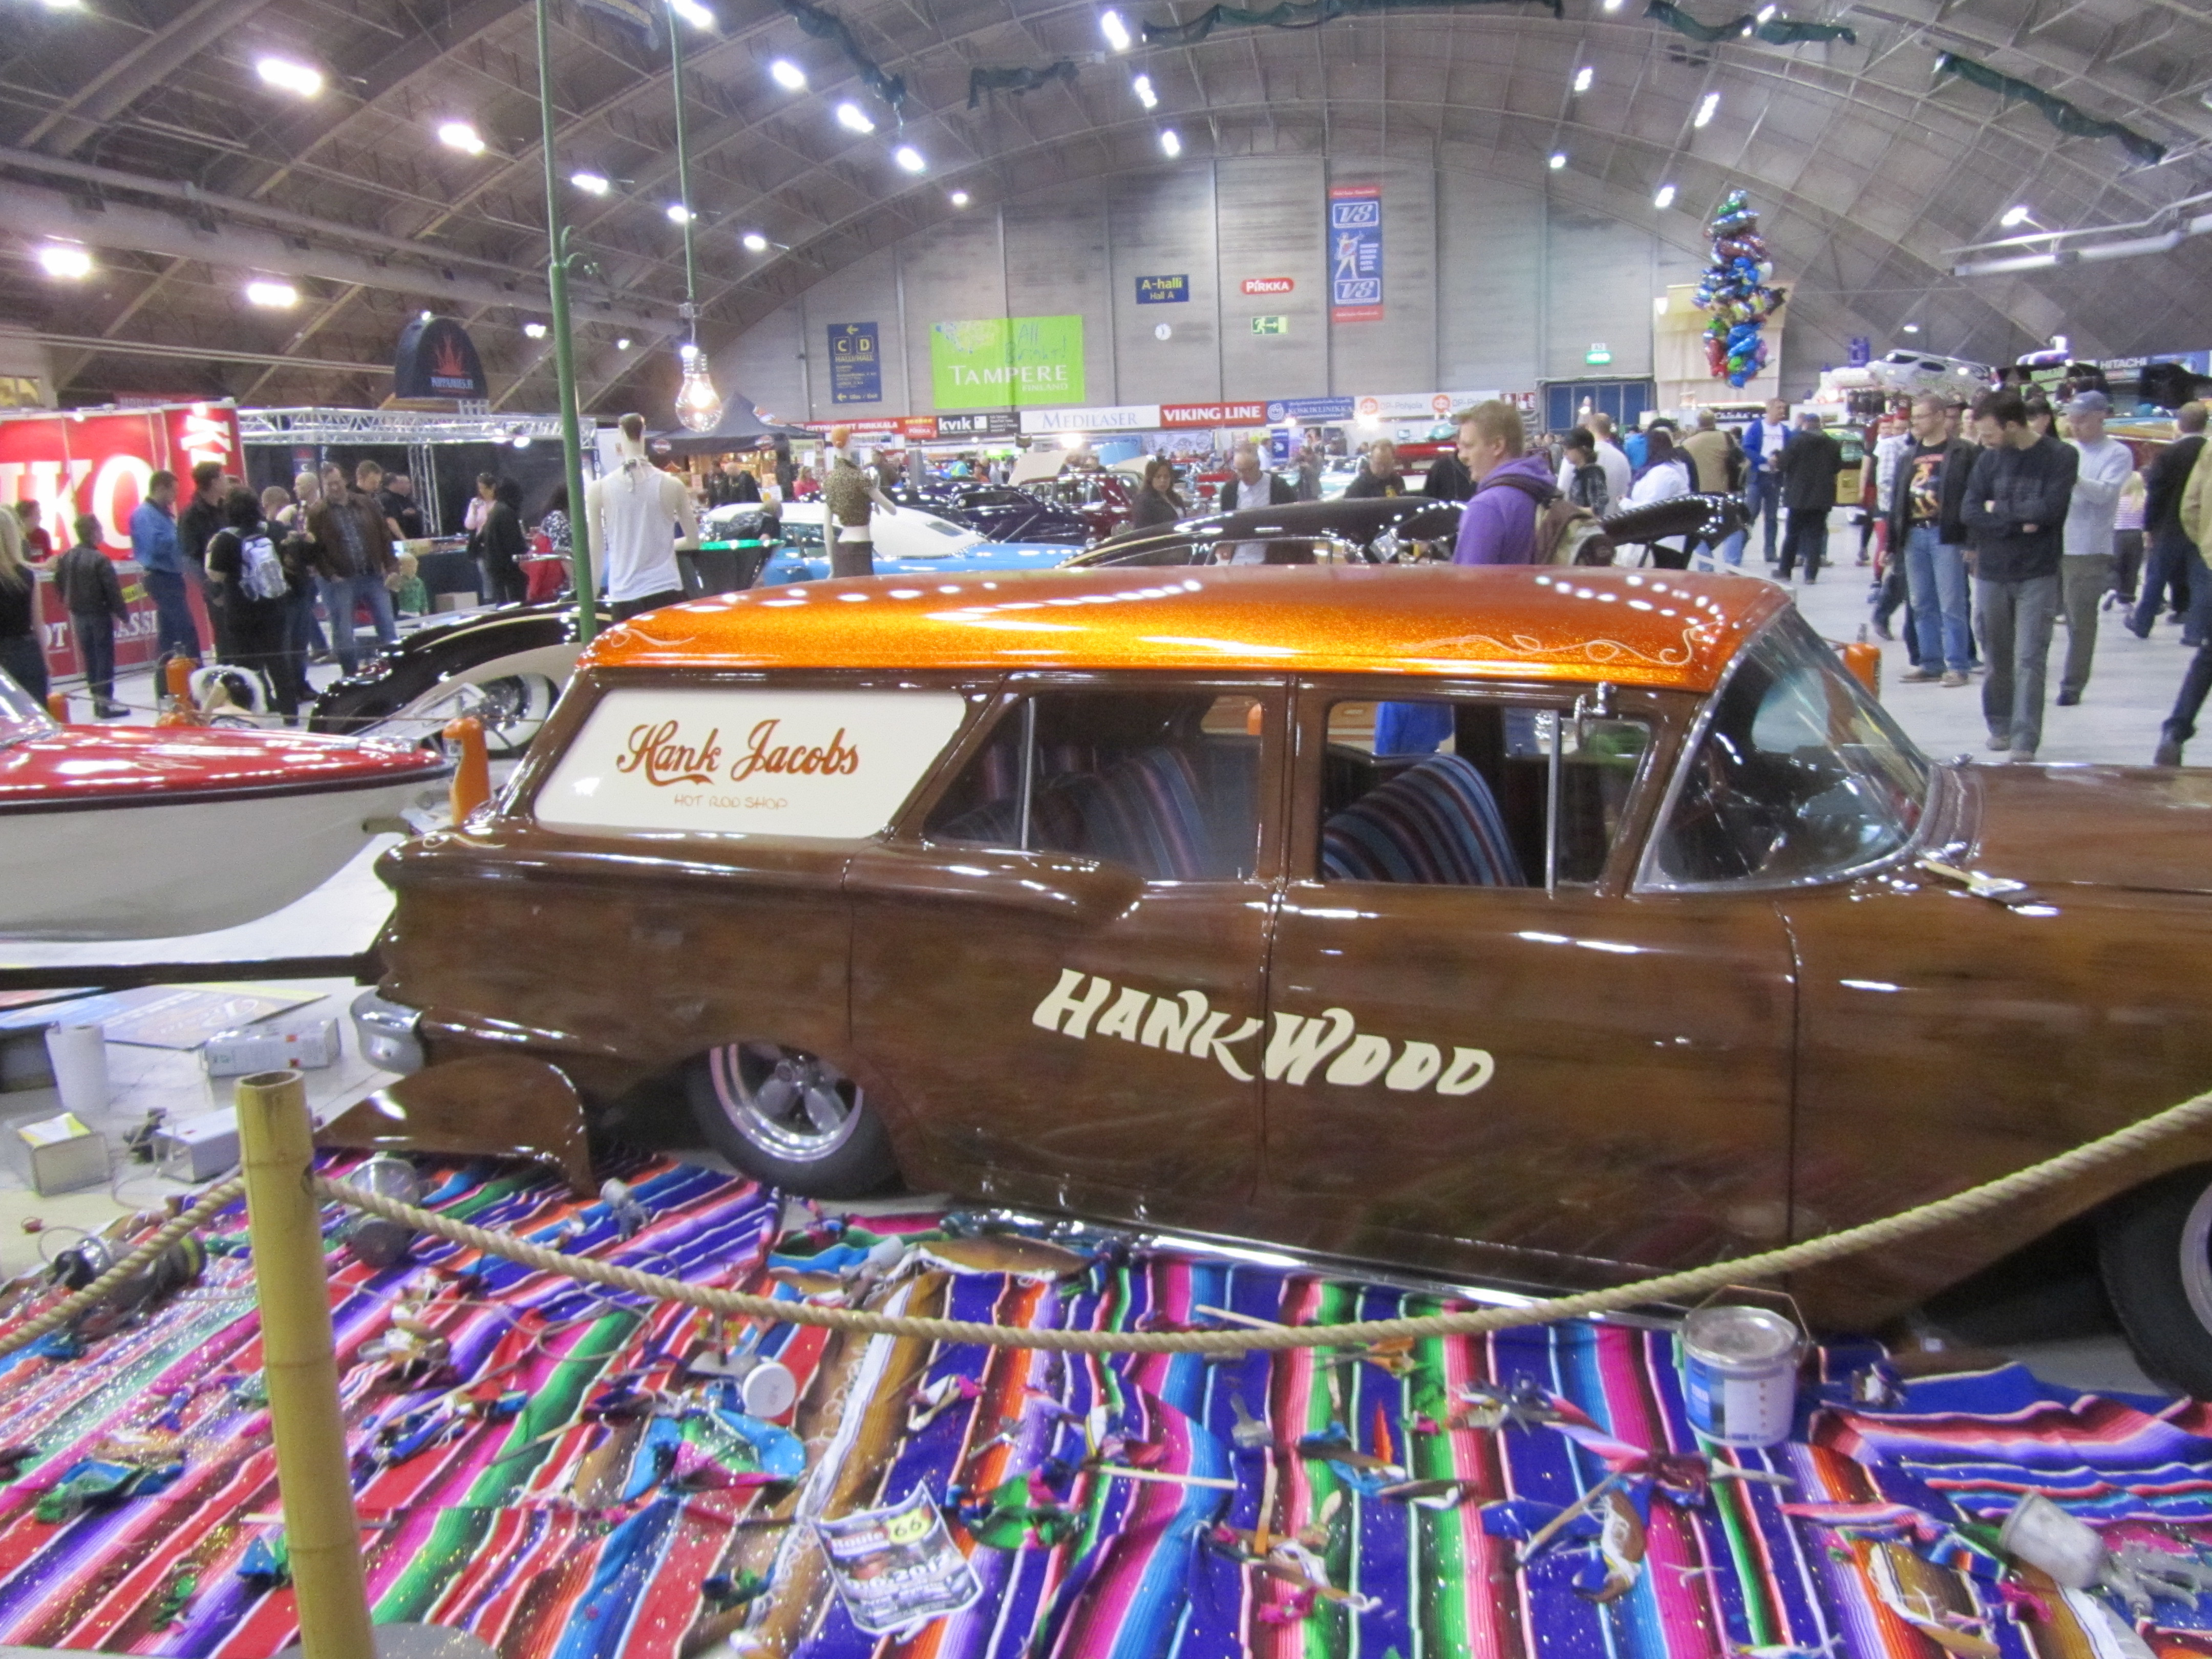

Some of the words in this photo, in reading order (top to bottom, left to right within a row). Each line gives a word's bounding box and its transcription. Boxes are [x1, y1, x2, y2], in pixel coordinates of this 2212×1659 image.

[1338, 205, 1373, 223] V8
[1142, 278, 1183, 289] A-halli
[1340, 281, 1375, 299] V8
[838, 340, 847, 351] C
[860, 338, 870, 351] D
[2100, 357, 2147, 369] HITACHI
[948, 365, 1068, 385] TAMPERE
[1022, 384, 1068, 392] FINLAND
[1043, 411, 1138, 429] MEDILASER
[1163, 407, 1222, 421] VIKING
[1224, 406, 1261, 419] LINE
[858, 421, 898, 430] PIRKKALA
[939, 417, 971, 431] kvik
[616, 720, 721, 786] Hank
[730, 719, 858, 781] Jacobs
[674, 794, 703, 807] HOT
[709, 796, 740, 807] ROD
[745, 797, 788, 810] SHOP
[894, 1517, 922, 1537] 66
